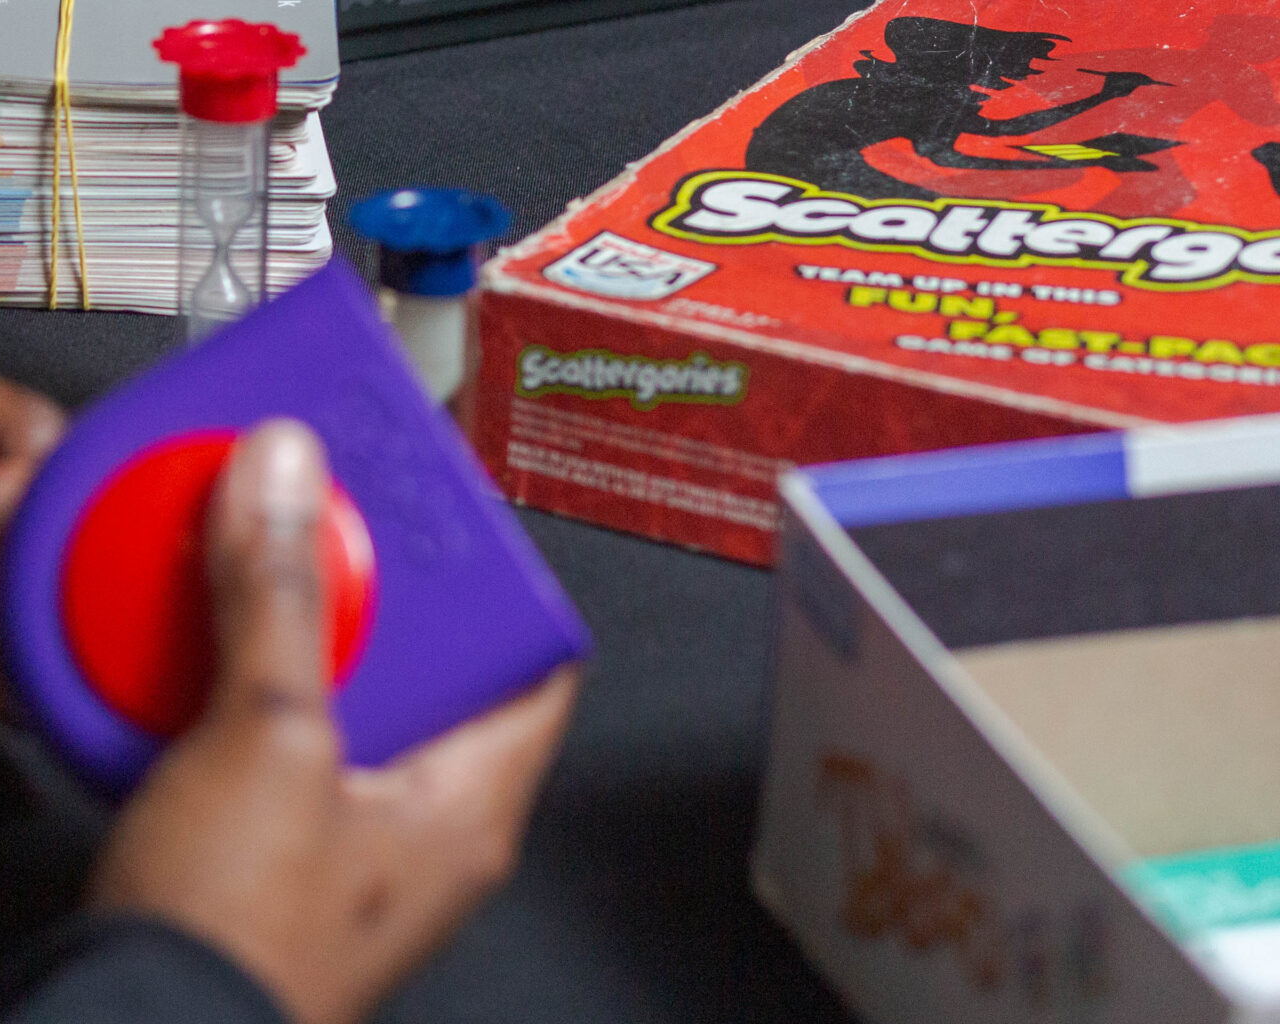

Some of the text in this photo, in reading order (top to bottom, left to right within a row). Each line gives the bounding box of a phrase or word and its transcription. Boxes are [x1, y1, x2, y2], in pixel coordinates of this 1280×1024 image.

[796, 264, 1121, 306] TEAM UP IN THIS
[848, 285, 1019, 324] FUN,
[1020, 347, 1076, 367] OF
